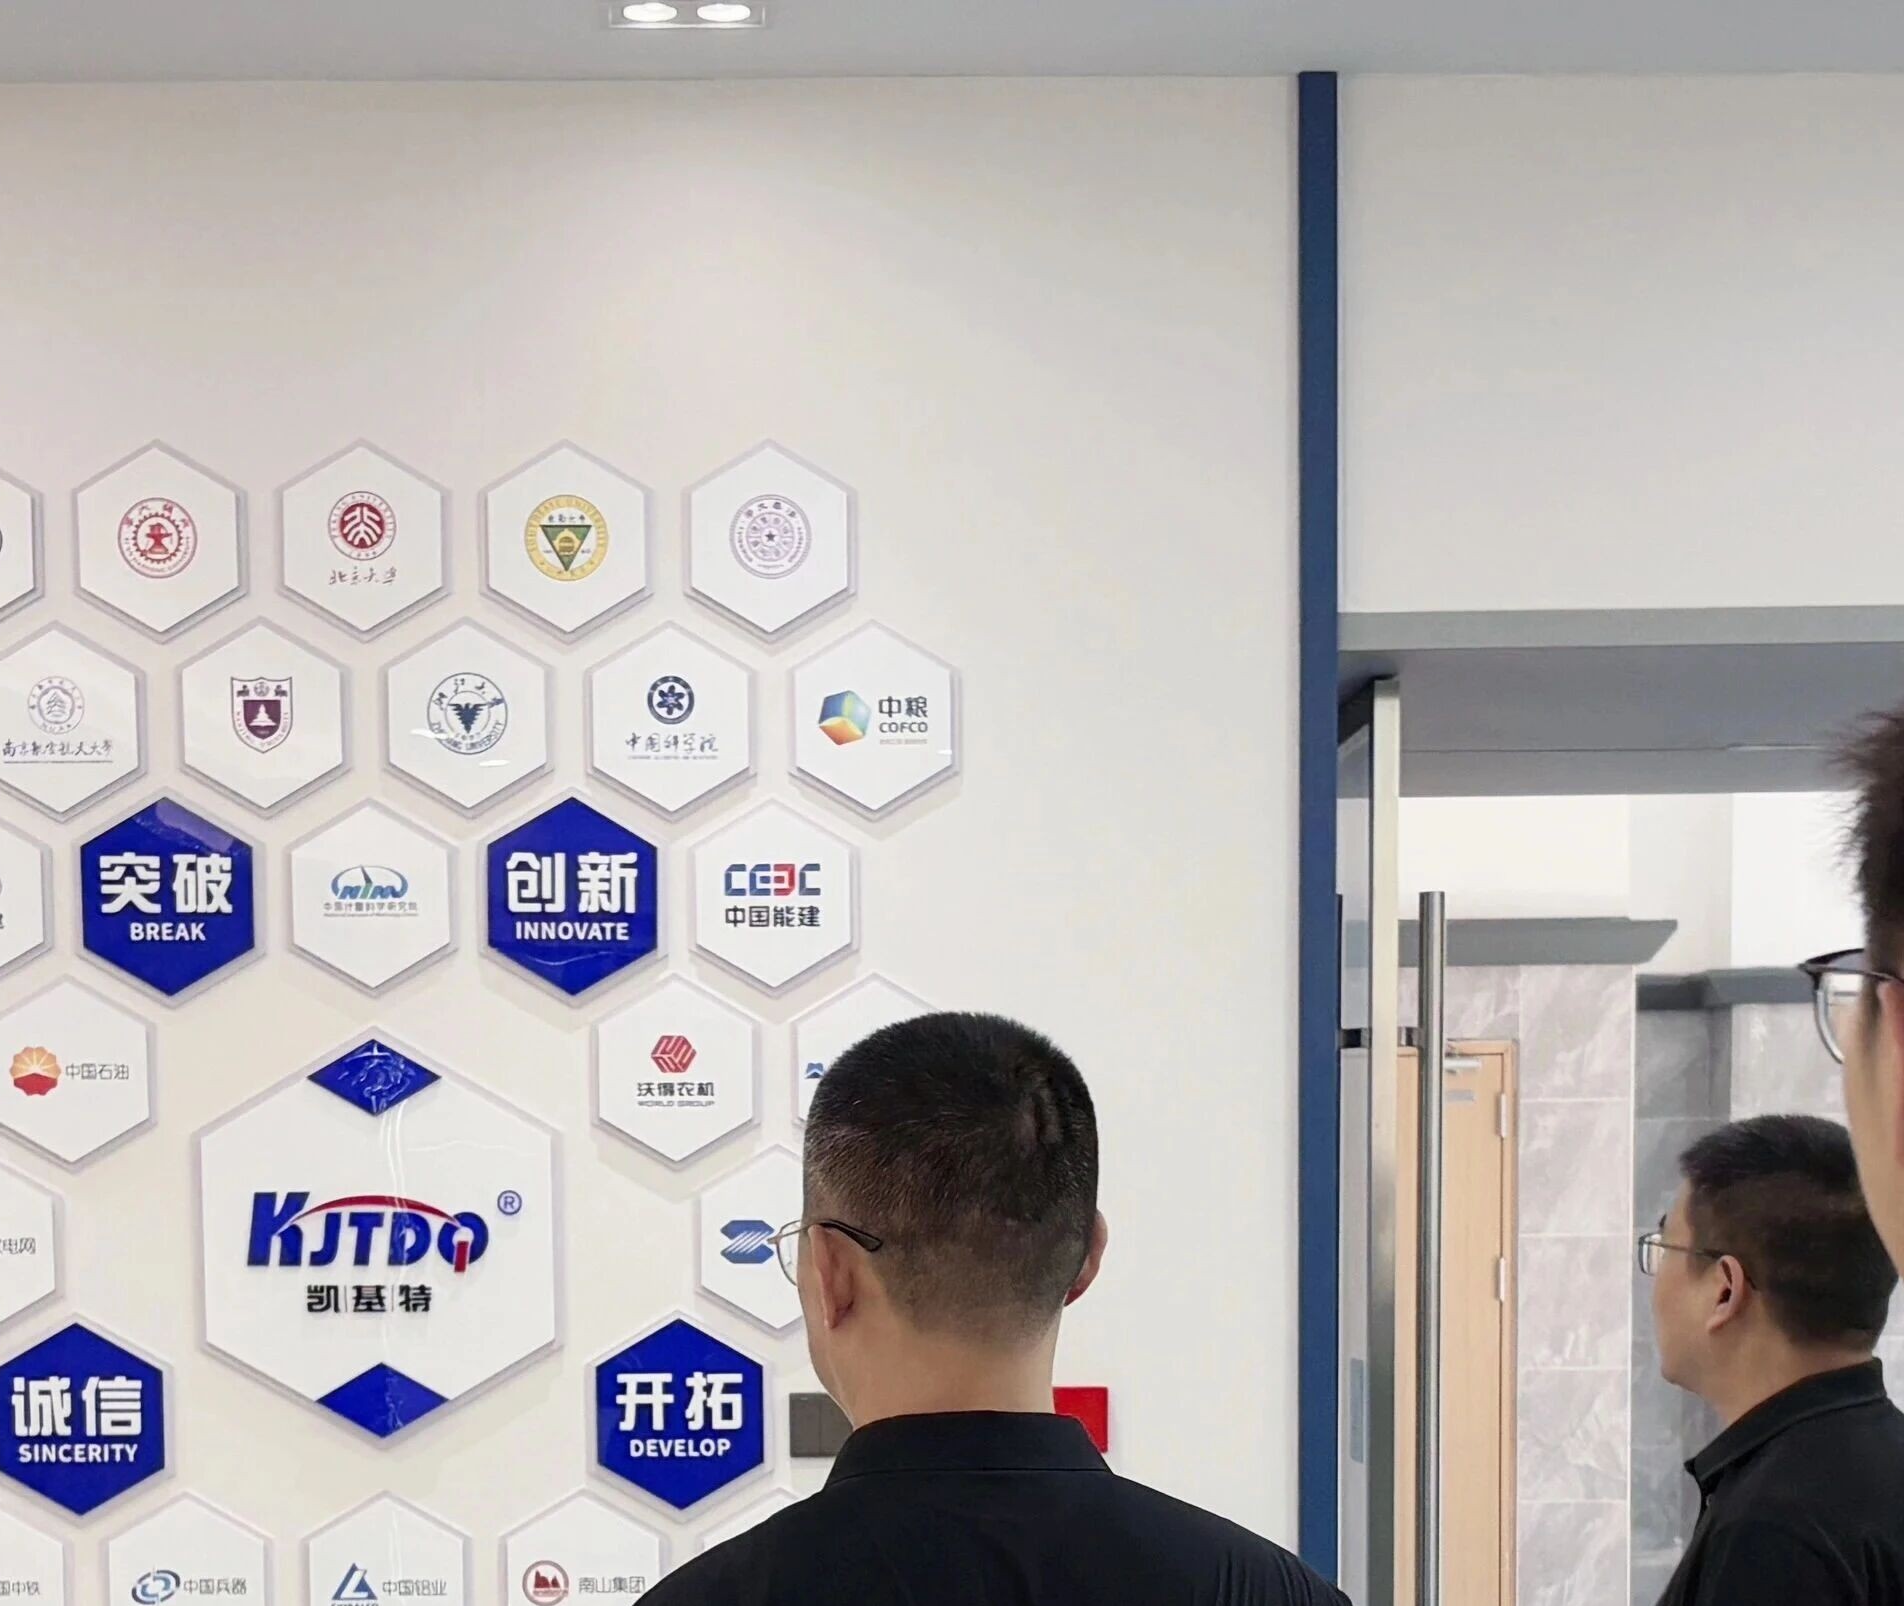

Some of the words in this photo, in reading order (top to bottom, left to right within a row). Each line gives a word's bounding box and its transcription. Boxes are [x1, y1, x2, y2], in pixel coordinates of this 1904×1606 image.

[878, 695, 929, 718] 中粮
[879, 721, 928, 734] COFCO
[99, 850, 234, 915] 突破
[506, 850, 638, 915] 创新
[725, 905, 821, 928] 中国能建
[130, 922, 207, 943] BREAK
[515, 921, 630, 942] INNOVATE
[65, 1063, 130, 1080] 中国石油
[636, 1081, 715, 1097] 沃得农机
[247, 1191, 489, 1273] KJTDQ
[307, 1284, 432, 1313] 凯基特
[11, 1375, 143, 1437] 诚信
[615, 1371, 743, 1432] 开拓
[18, 1443, 138, 1463] SINCERITY
[629, 1437, 732, 1458] DEVELOP
[183, 1577, 247, 1595] 中国兵器
[381, 1579, 447, 1597] 中国铝业
[578, 1575, 646, 1595] 南山集团
